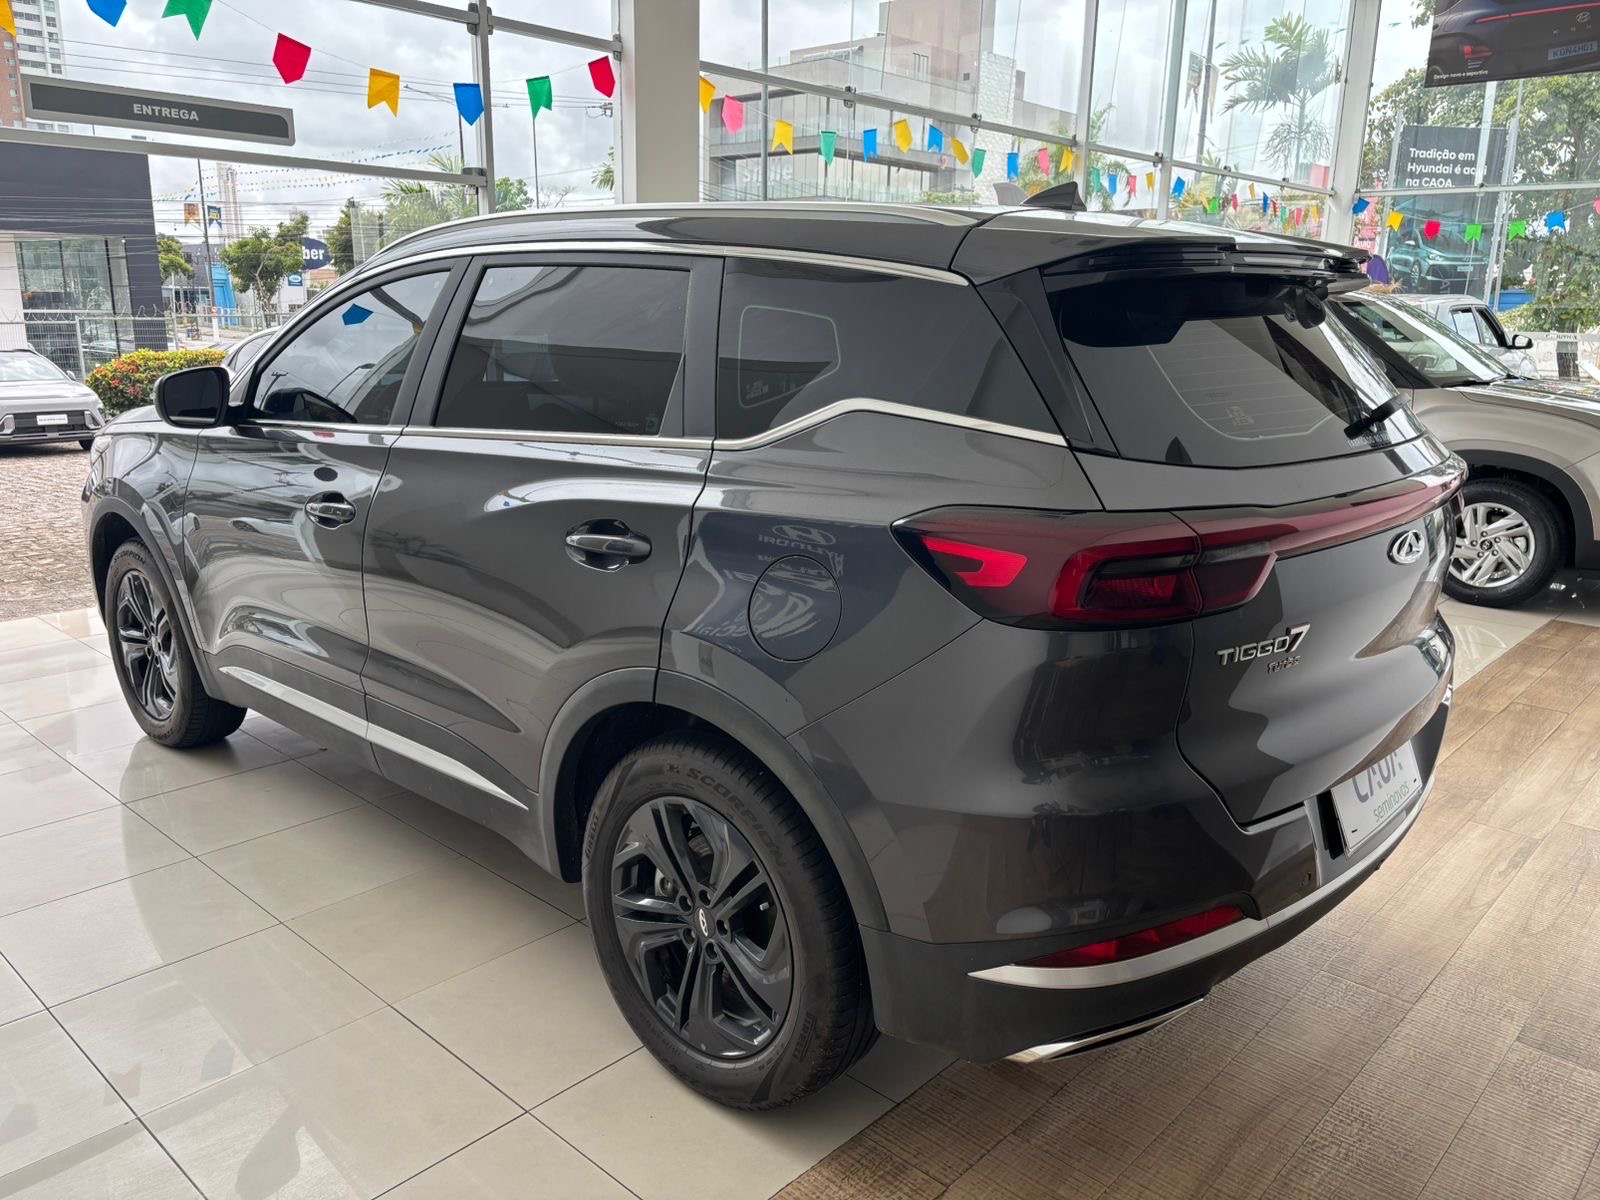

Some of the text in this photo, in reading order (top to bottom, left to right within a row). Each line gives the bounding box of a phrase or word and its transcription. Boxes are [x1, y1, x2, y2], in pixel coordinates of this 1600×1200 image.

[132, 103, 200, 121] ENTREGA
[1409, 147, 1475, 161] Tradição em
[1407, 162, 1488, 176] Hyundai é aqi
[1405, 177, 1456, 188] na CAOA.
[302, 245, 325, 260] ber
[1373, 783, 1410, 823] seminovos
